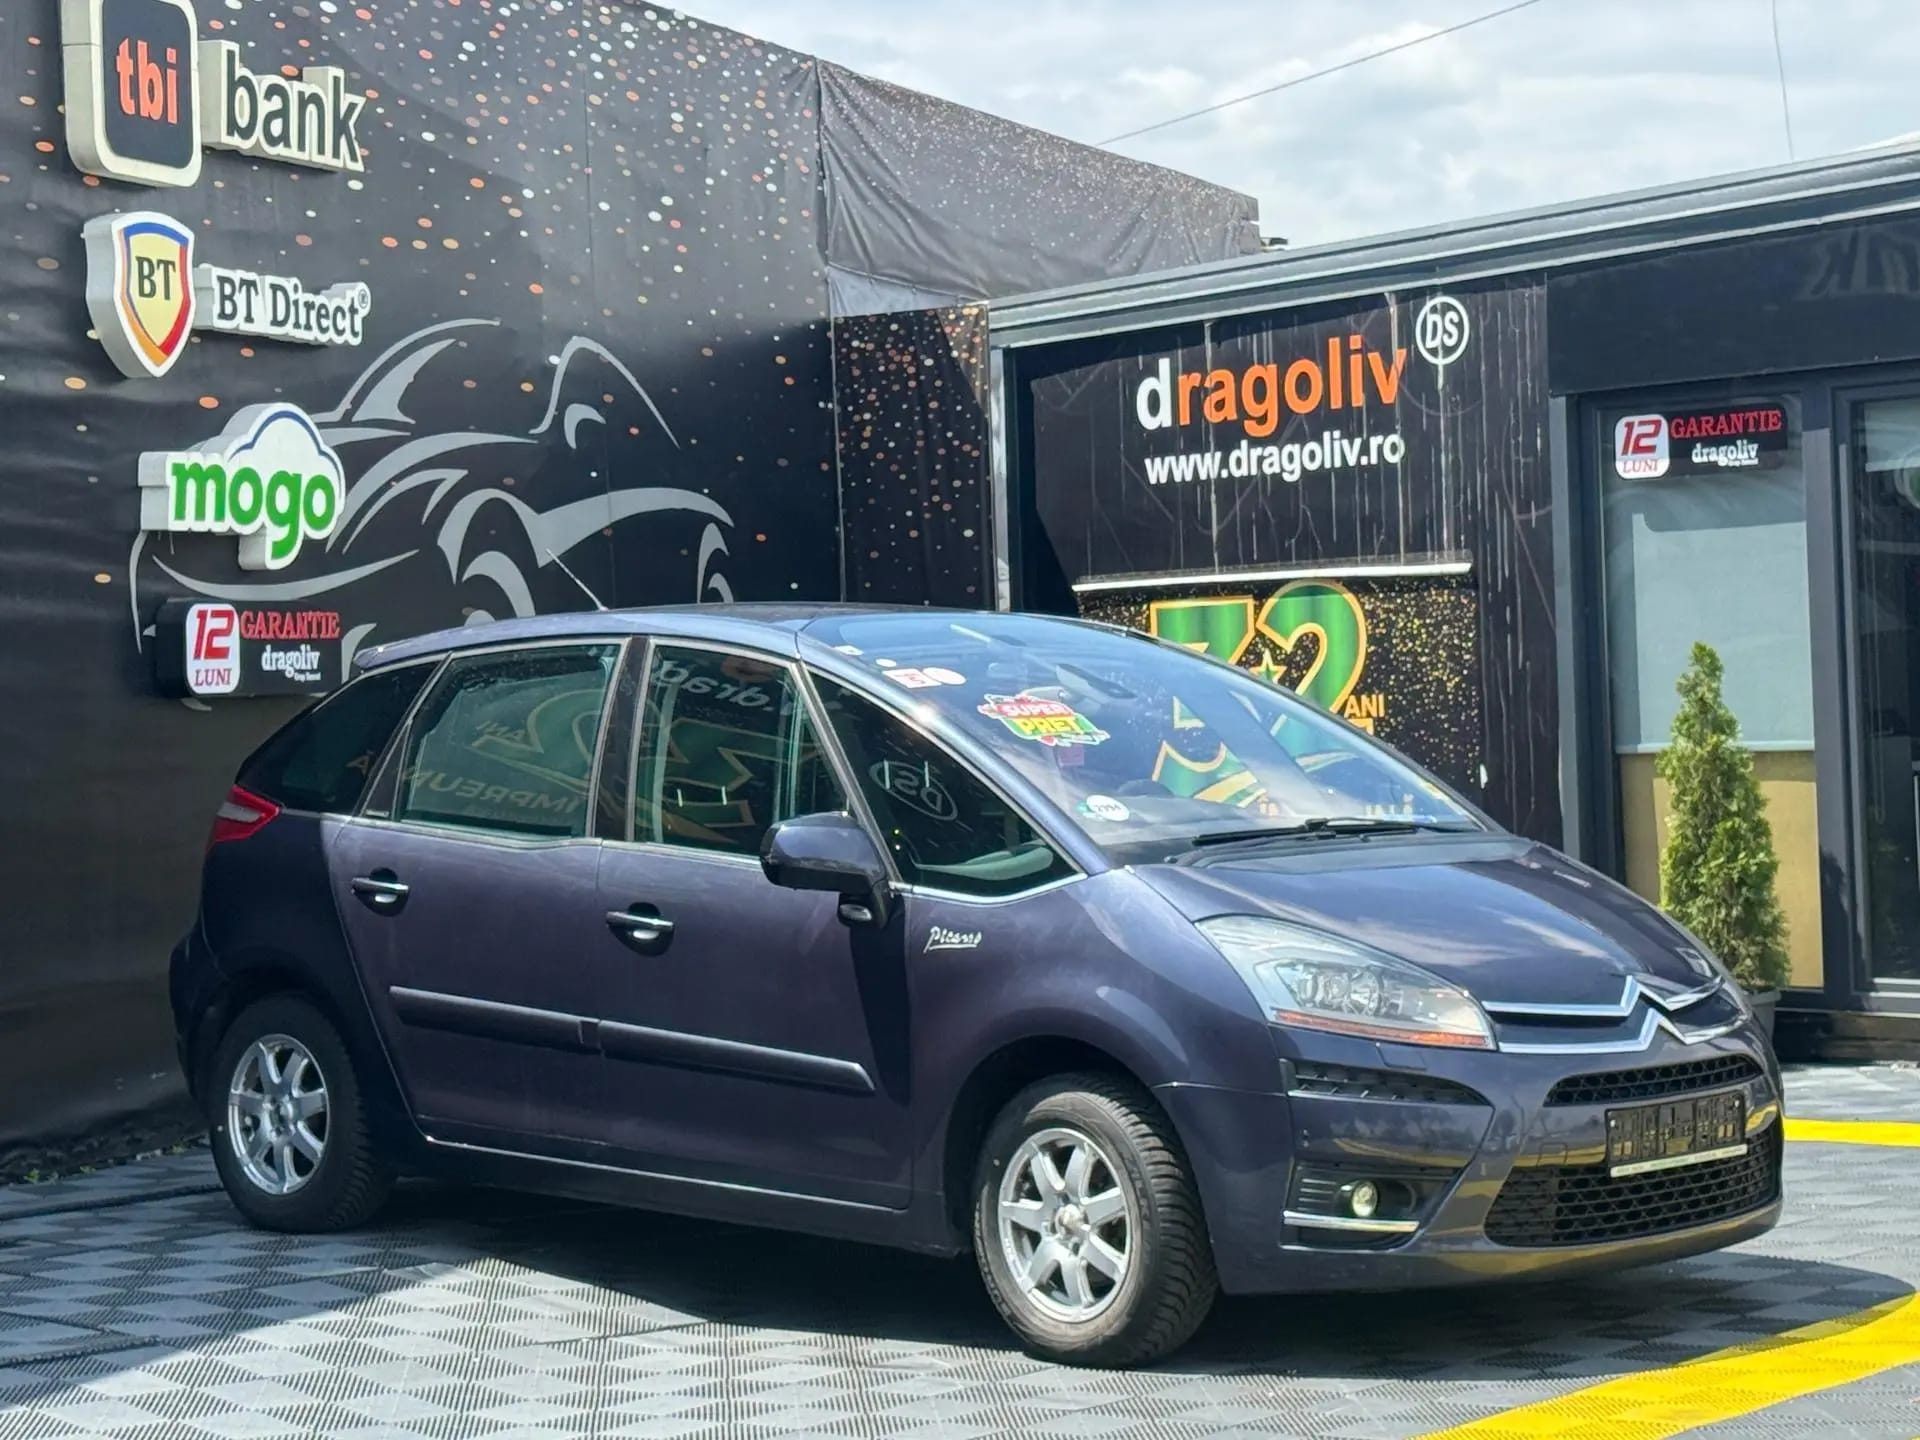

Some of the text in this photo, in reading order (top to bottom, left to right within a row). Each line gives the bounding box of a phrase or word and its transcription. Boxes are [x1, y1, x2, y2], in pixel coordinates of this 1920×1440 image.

[116, 38, 360, 163] tbi bank
[136, 256, 176, 300] BT
[216, 276, 260, 323] BT
[1424, 310, 1460, 350] DS
[1136, 334, 1407, 437] dragoliv
[1621, 410, 1782, 456] 12 GARANTIE
[1691, 439, 1759, 466] dragoliv
[1145, 430, 1406, 486] www.dragoliv.ro
[1623, 459, 1659, 473] LUNI
[171, 462, 336, 560] mogo
[194, 609, 340, 660] 12 GARANTIE
[195, 668, 232, 687] LUNI
[261, 643, 320, 678] dragoliv
[1344, 693, 1385, 719] ANI
